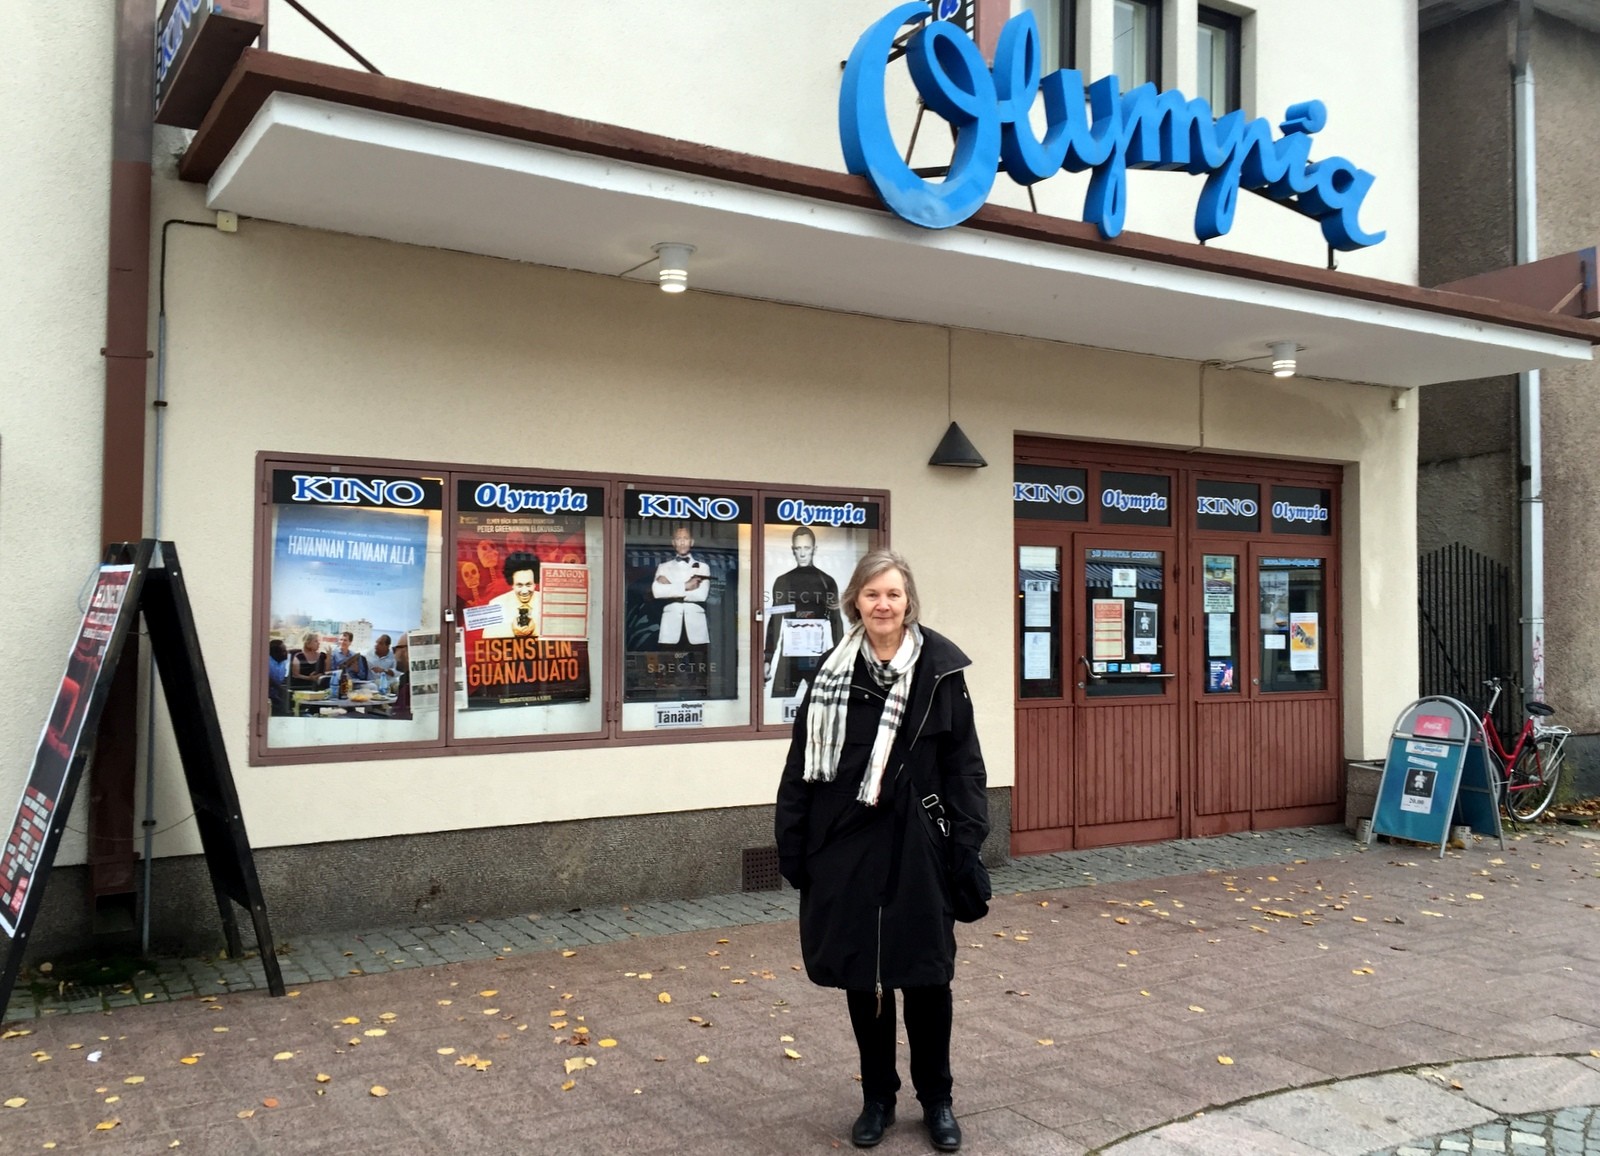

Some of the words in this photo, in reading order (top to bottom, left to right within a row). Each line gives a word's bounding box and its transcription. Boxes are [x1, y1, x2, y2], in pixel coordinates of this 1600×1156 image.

[839, 0, 1386, 251] Olympia
[292, 475, 425, 506] KINO
[475, 483, 588, 514] Olympia
[1013, 483, 1084, 504] KINO
[1101, 489, 1167, 512] Olympia
[639, 494, 740, 520] KINO
[778, 500, 866, 526] Olympia
[1197, 497, 1258, 517] KINO
[1272, 501, 1328, 523] Olympia
[288, 535, 345, 559] HAVANNAN
[346, 540, 388, 563] TAIVAAN
[390, 545, 415, 565] ALLA
[763, 591, 838, 603] SPECTR
[474, 638, 573, 663] EISENSTEIN
[468, 658, 579, 687] GUANAJUATO
[647, 662, 717, 673] SPECTRE
[657, 709, 703, 723] Tänään!
